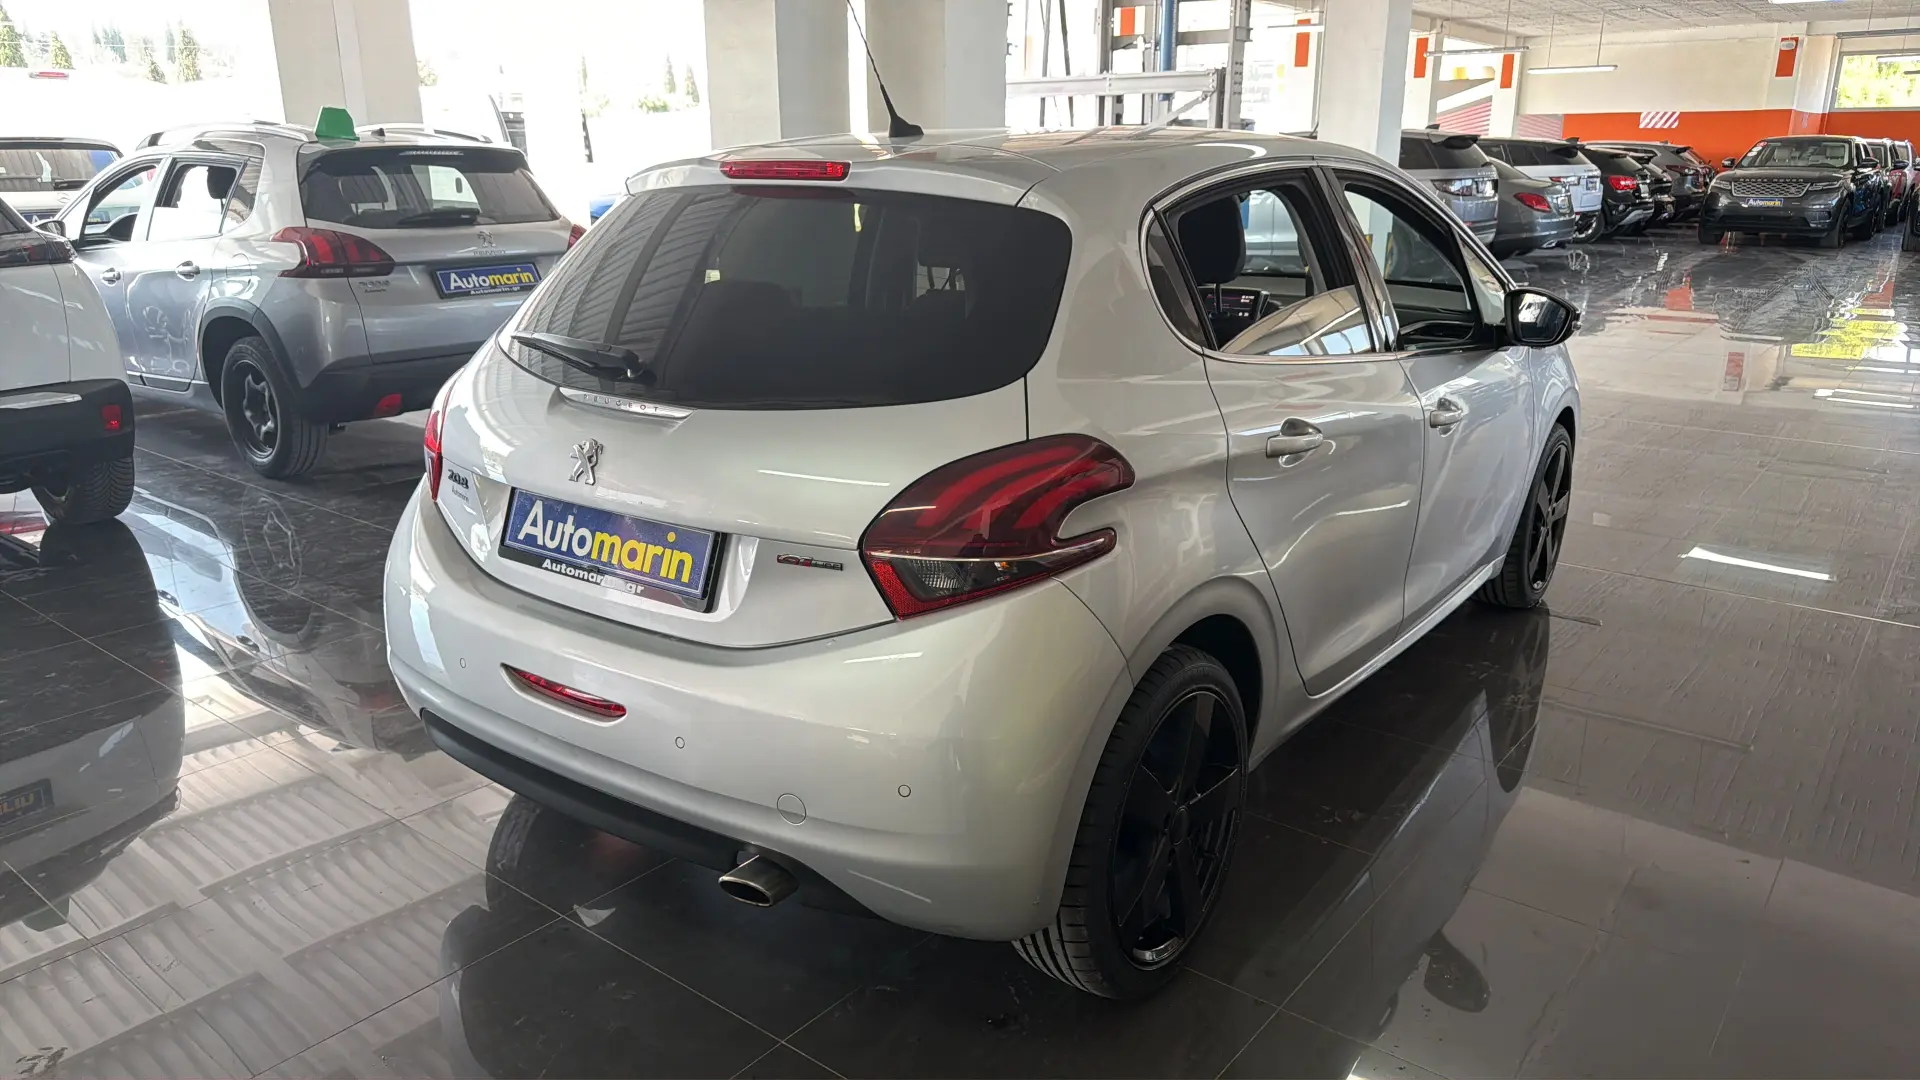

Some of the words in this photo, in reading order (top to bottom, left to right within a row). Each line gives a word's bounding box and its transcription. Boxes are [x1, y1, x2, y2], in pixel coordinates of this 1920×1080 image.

[1748, 198, 1781, 206] Automarin
[450, 267, 535, 290] Automarin
[470, 286, 521, 295] Automarin.gr
[583, 393, 659, 413] PEUGEOT
[447, 468, 470, 490] 208
[517, 499, 694, 584] Automarin
